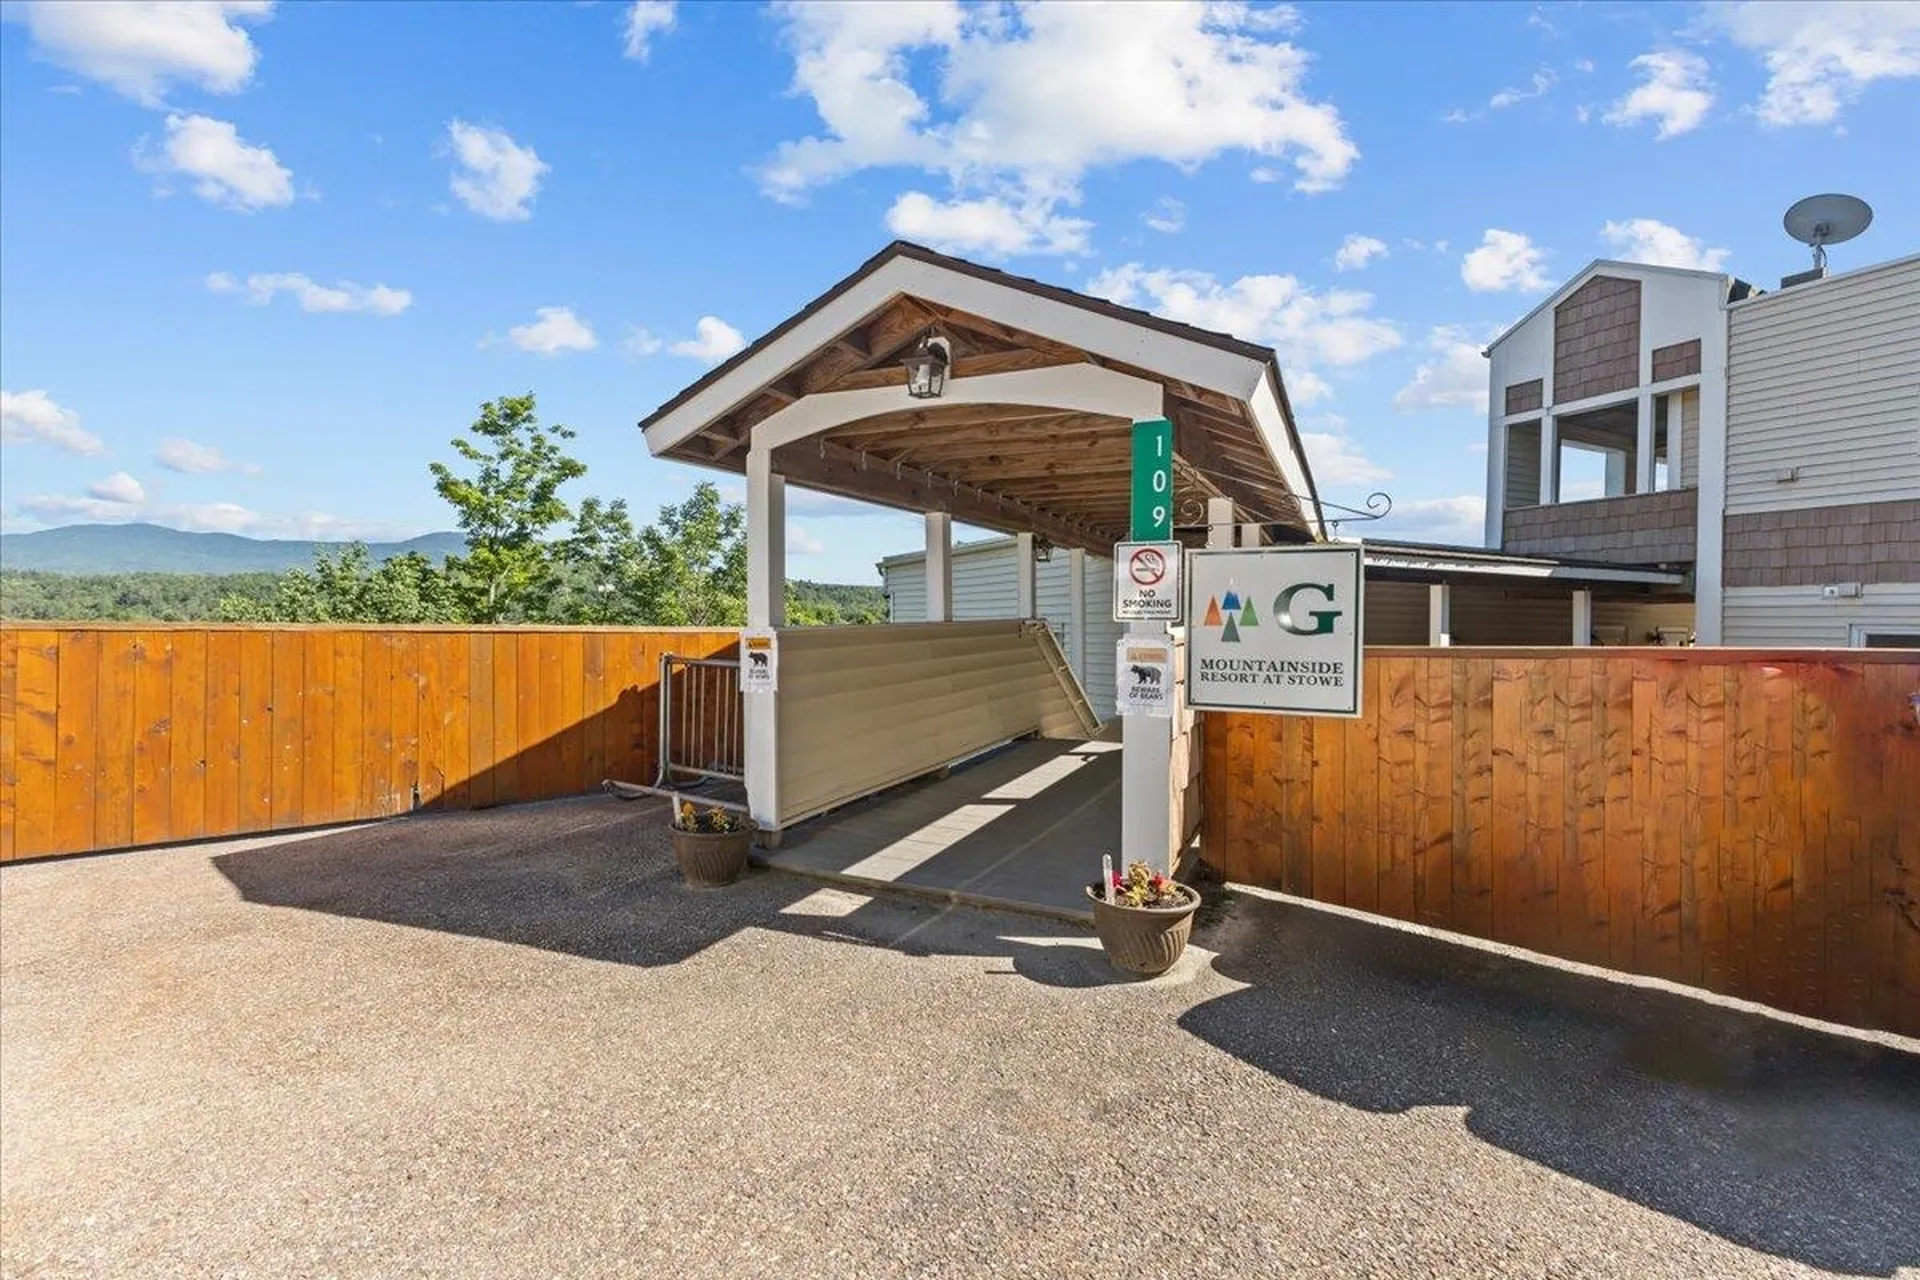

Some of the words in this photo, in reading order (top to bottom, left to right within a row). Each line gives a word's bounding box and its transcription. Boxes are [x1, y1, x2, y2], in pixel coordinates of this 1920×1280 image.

[1153, 435, 1167, 528] 109
[1139, 589, 1156, 598] NO
[1122, 599, 1172, 608] SMOKING
[1273, 583, 1343, 636] G
[1200, 658, 1344, 674] MOUNTAINSIDE
[1200, 671, 1260, 684] RESORT
[1263, 673, 1283, 685] AT
[1287, 674, 1344, 687] STOWE
